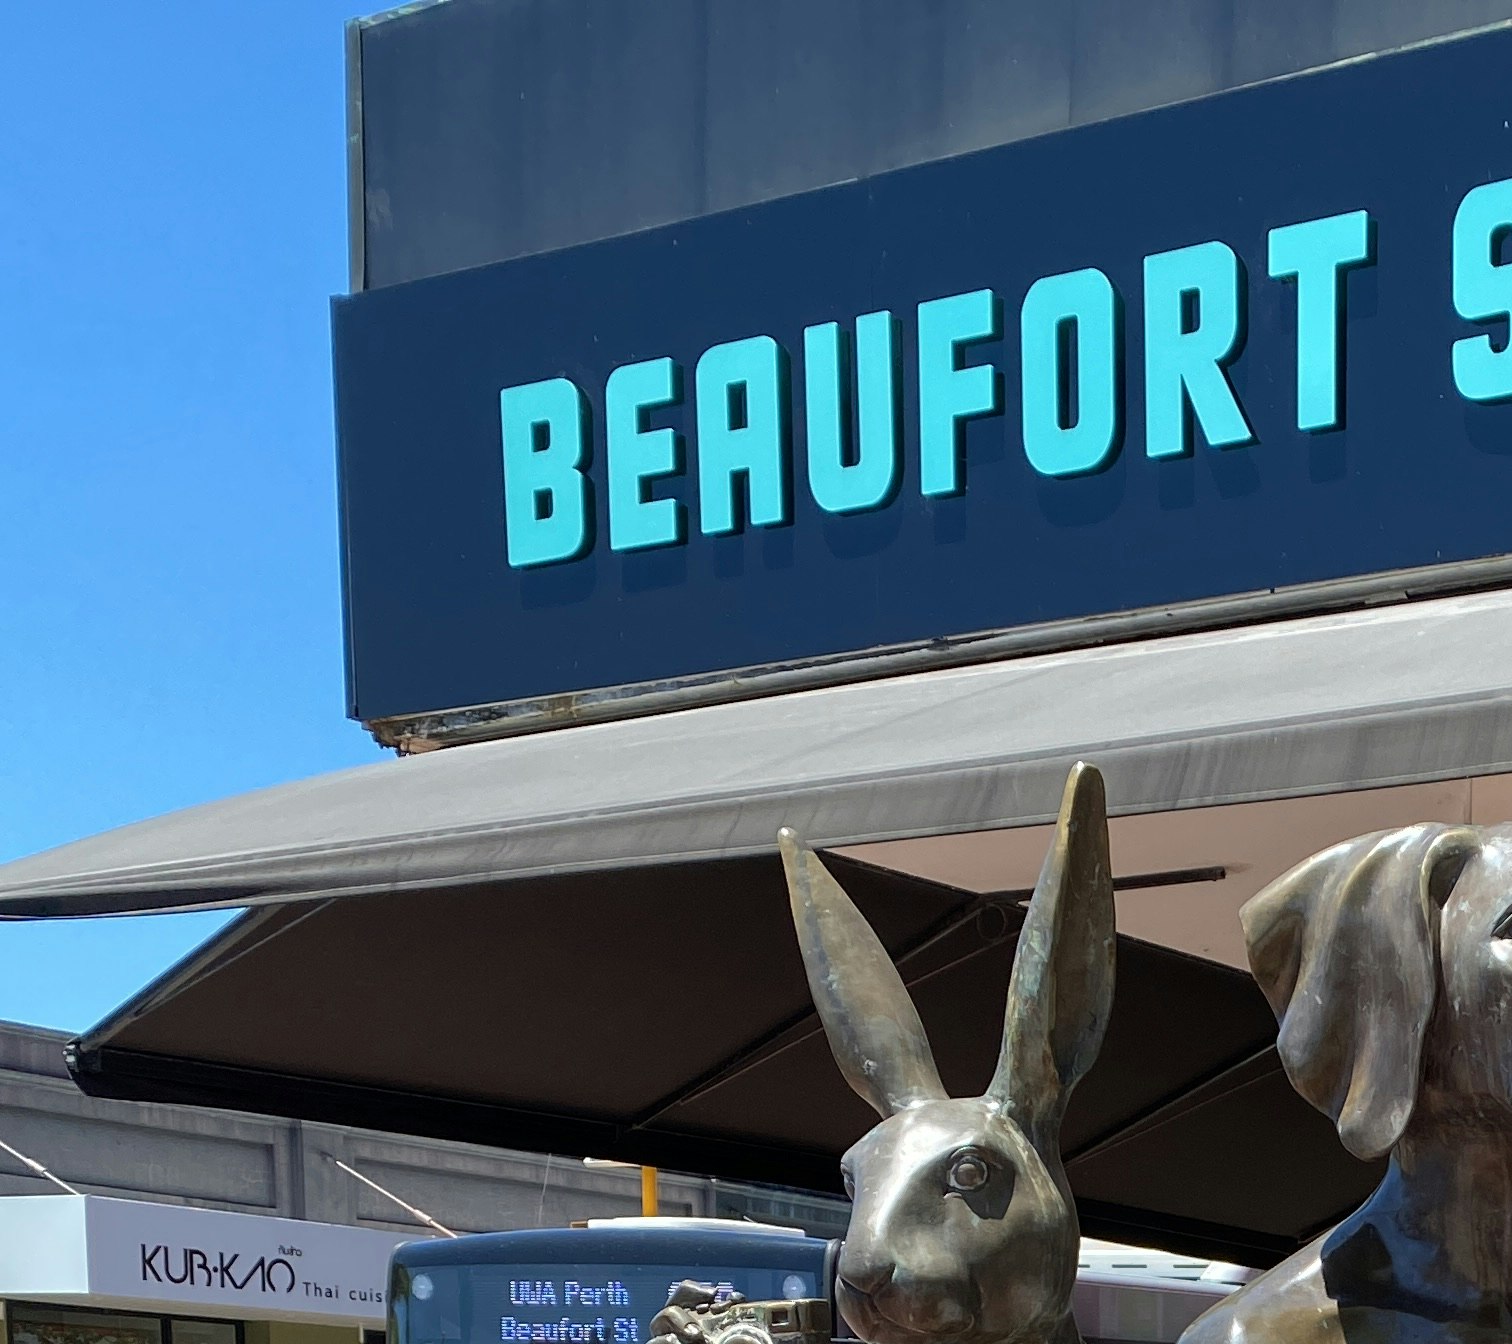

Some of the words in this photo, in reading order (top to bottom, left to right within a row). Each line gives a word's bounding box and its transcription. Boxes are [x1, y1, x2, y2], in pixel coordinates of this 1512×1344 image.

[500, 209, 1376, 570] BEAUFORT
[302, 1281, 340, 1300] Thai
[349, 1287, 384, 1304] cuis
[509, 1280, 557, 1306] UWA
[564, 1280, 630, 1306] Perth
[500, 1316, 607, 1342] Beaufort
[613, 1317, 639, 1342] St
